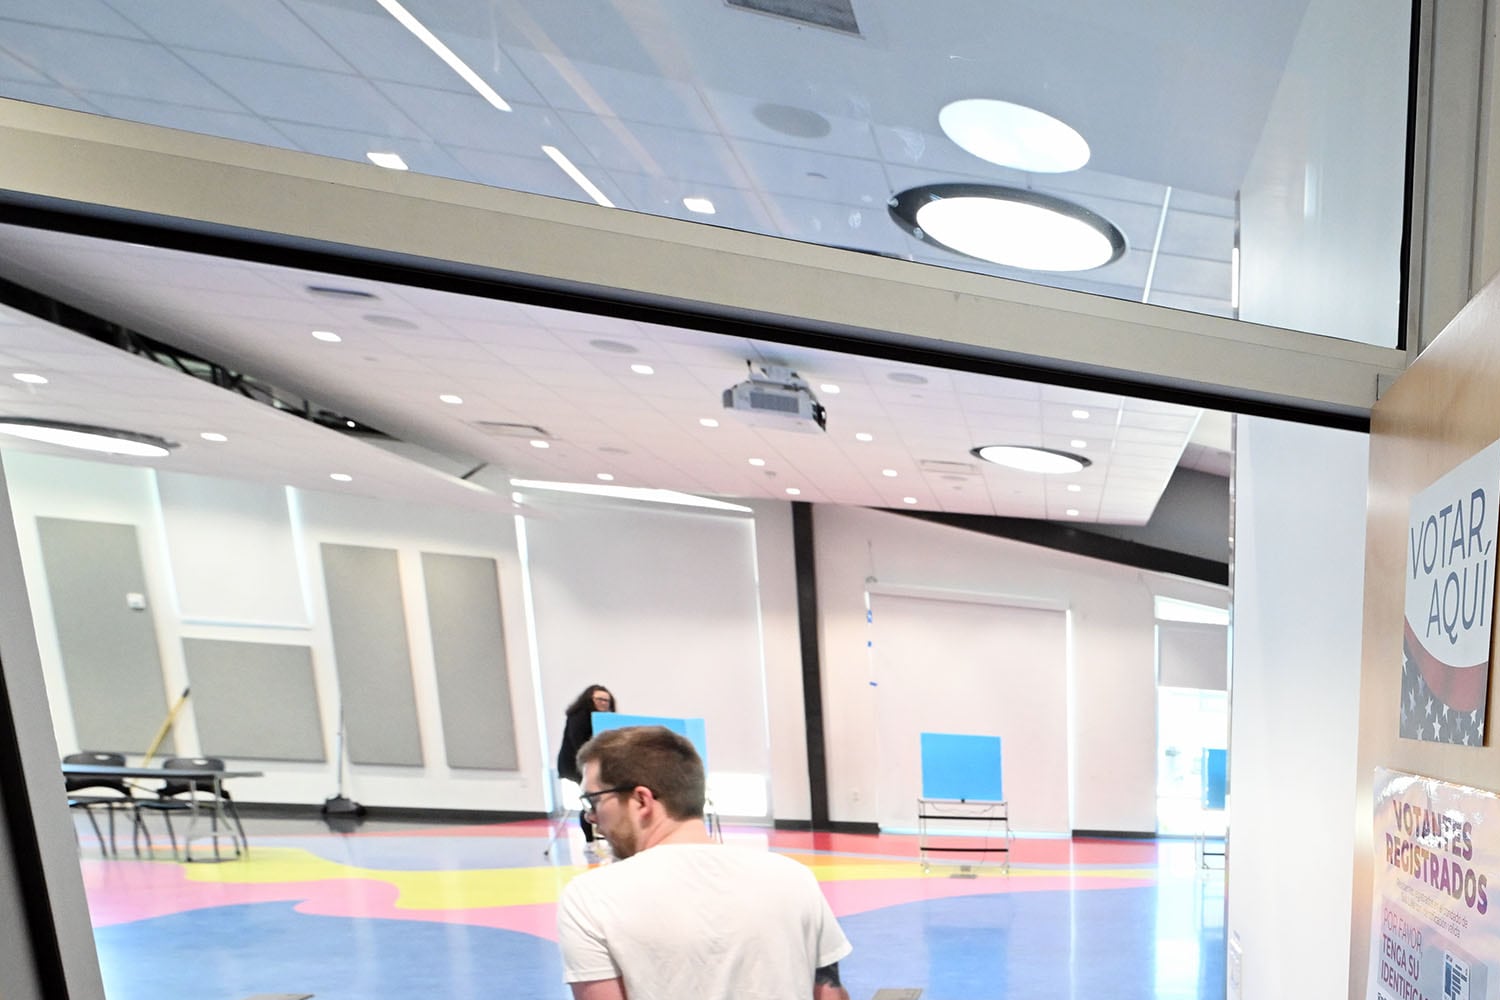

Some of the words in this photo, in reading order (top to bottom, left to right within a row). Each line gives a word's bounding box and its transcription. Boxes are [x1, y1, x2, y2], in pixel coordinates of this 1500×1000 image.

[1411, 488, 1486, 580] VOTAR
[1426, 540, 1492, 645] AQUÍ
[1386, 833, 1488, 915] REGISTRADOS
[1383, 933, 1407, 972] TENGA
[1408, 954, 1420, 982] SU
